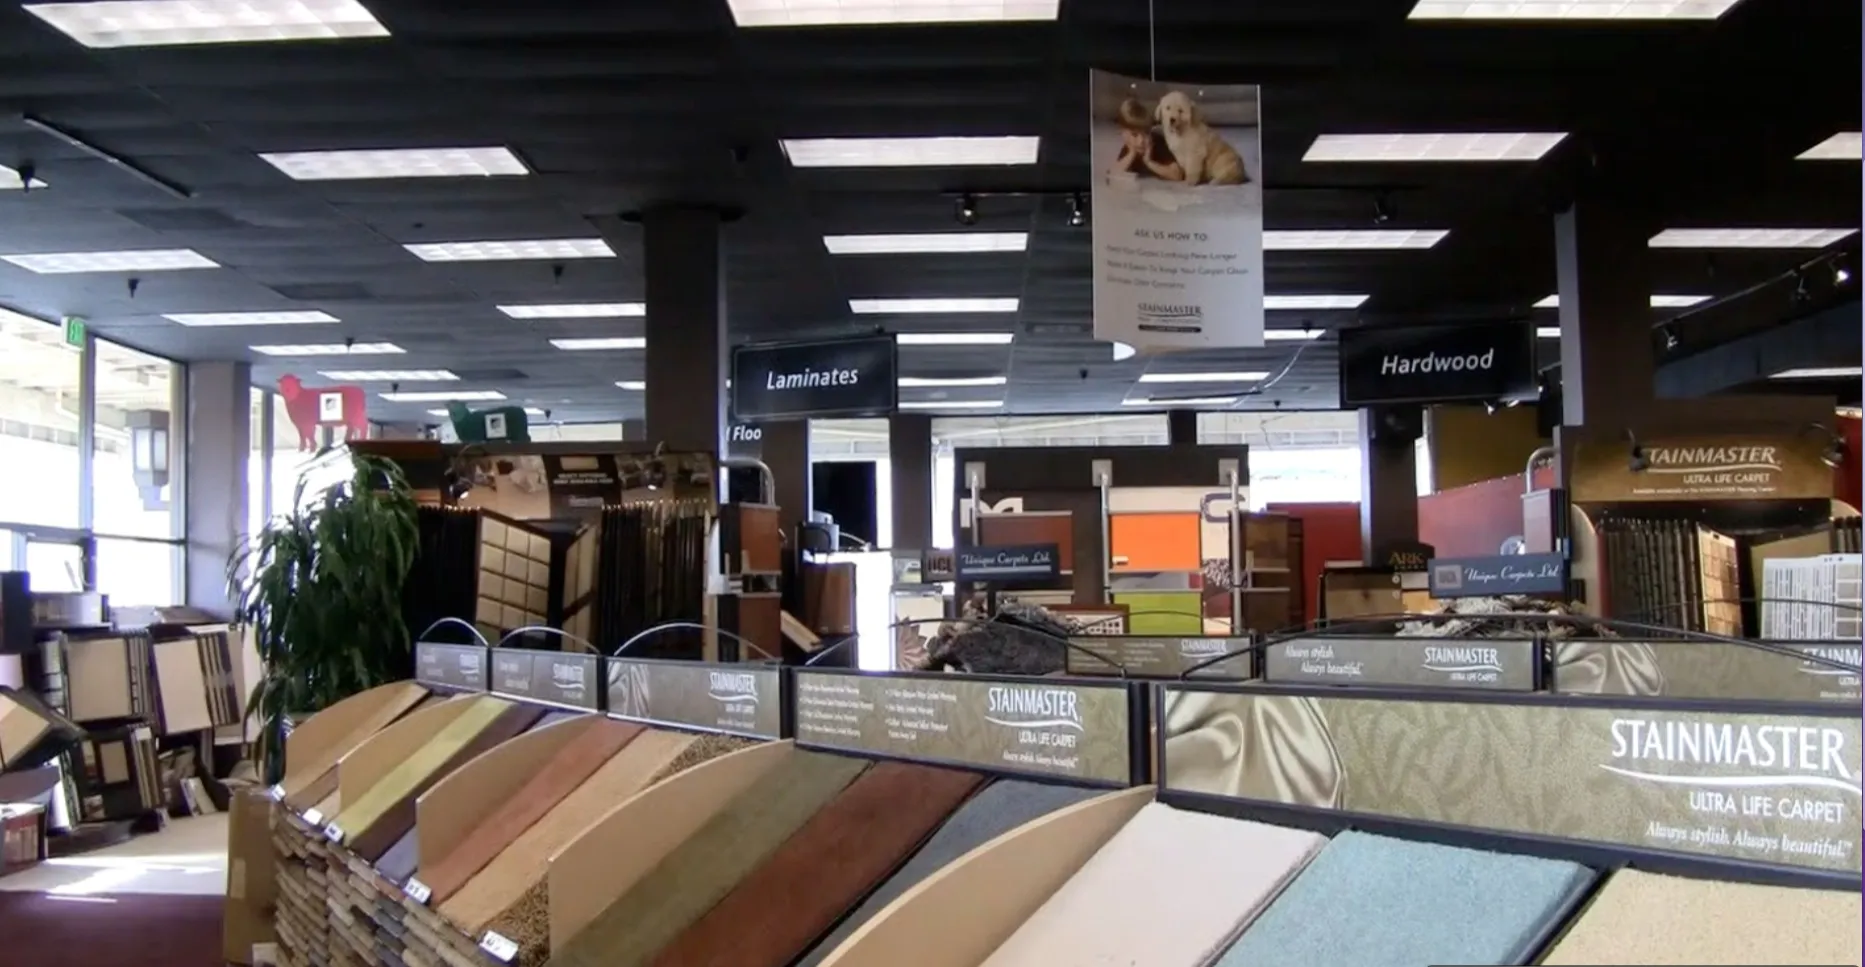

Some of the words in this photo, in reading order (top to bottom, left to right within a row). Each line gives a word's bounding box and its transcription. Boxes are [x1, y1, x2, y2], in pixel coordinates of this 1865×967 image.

[1134, 229, 1150, 238] ASK
[1153, 230, 1165, 239] US
[1168, 231, 1191, 241] HOW
[1136, 302, 1202, 315] STAINMASTER
[1381, 347, 1495, 375] Hardwood
[766, 367, 859, 391] Laminates
[1645, 446, 1777, 465] TAINMASTER
[1683, 474, 1712, 484] ULTRA
[1714, 474, 1732, 484] LIFE
[1734, 473, 1770, 484] CARPET
[997, 552, 1029, 569] Carpets
[1500, 565, 1535, 584] Carpets
[1424, 646, 1500, 667] STAINMASTER
[1802, 648, 1862, 667] STAINM
[709, 671, 758, 696] STAINMASTER
[988, 687, 1078, 722] STAINMASTER
[1610, 718, 1852, 779] STAINMASTER
[1688, 790, 1737, 814] ULTRA
[1741, 795, 1773, 817] LIFE
[1777, 798, 1845, 825] CARPET
[1645, 821, 1687, 842] Always
[1732, 829, 1779, 853] Always
